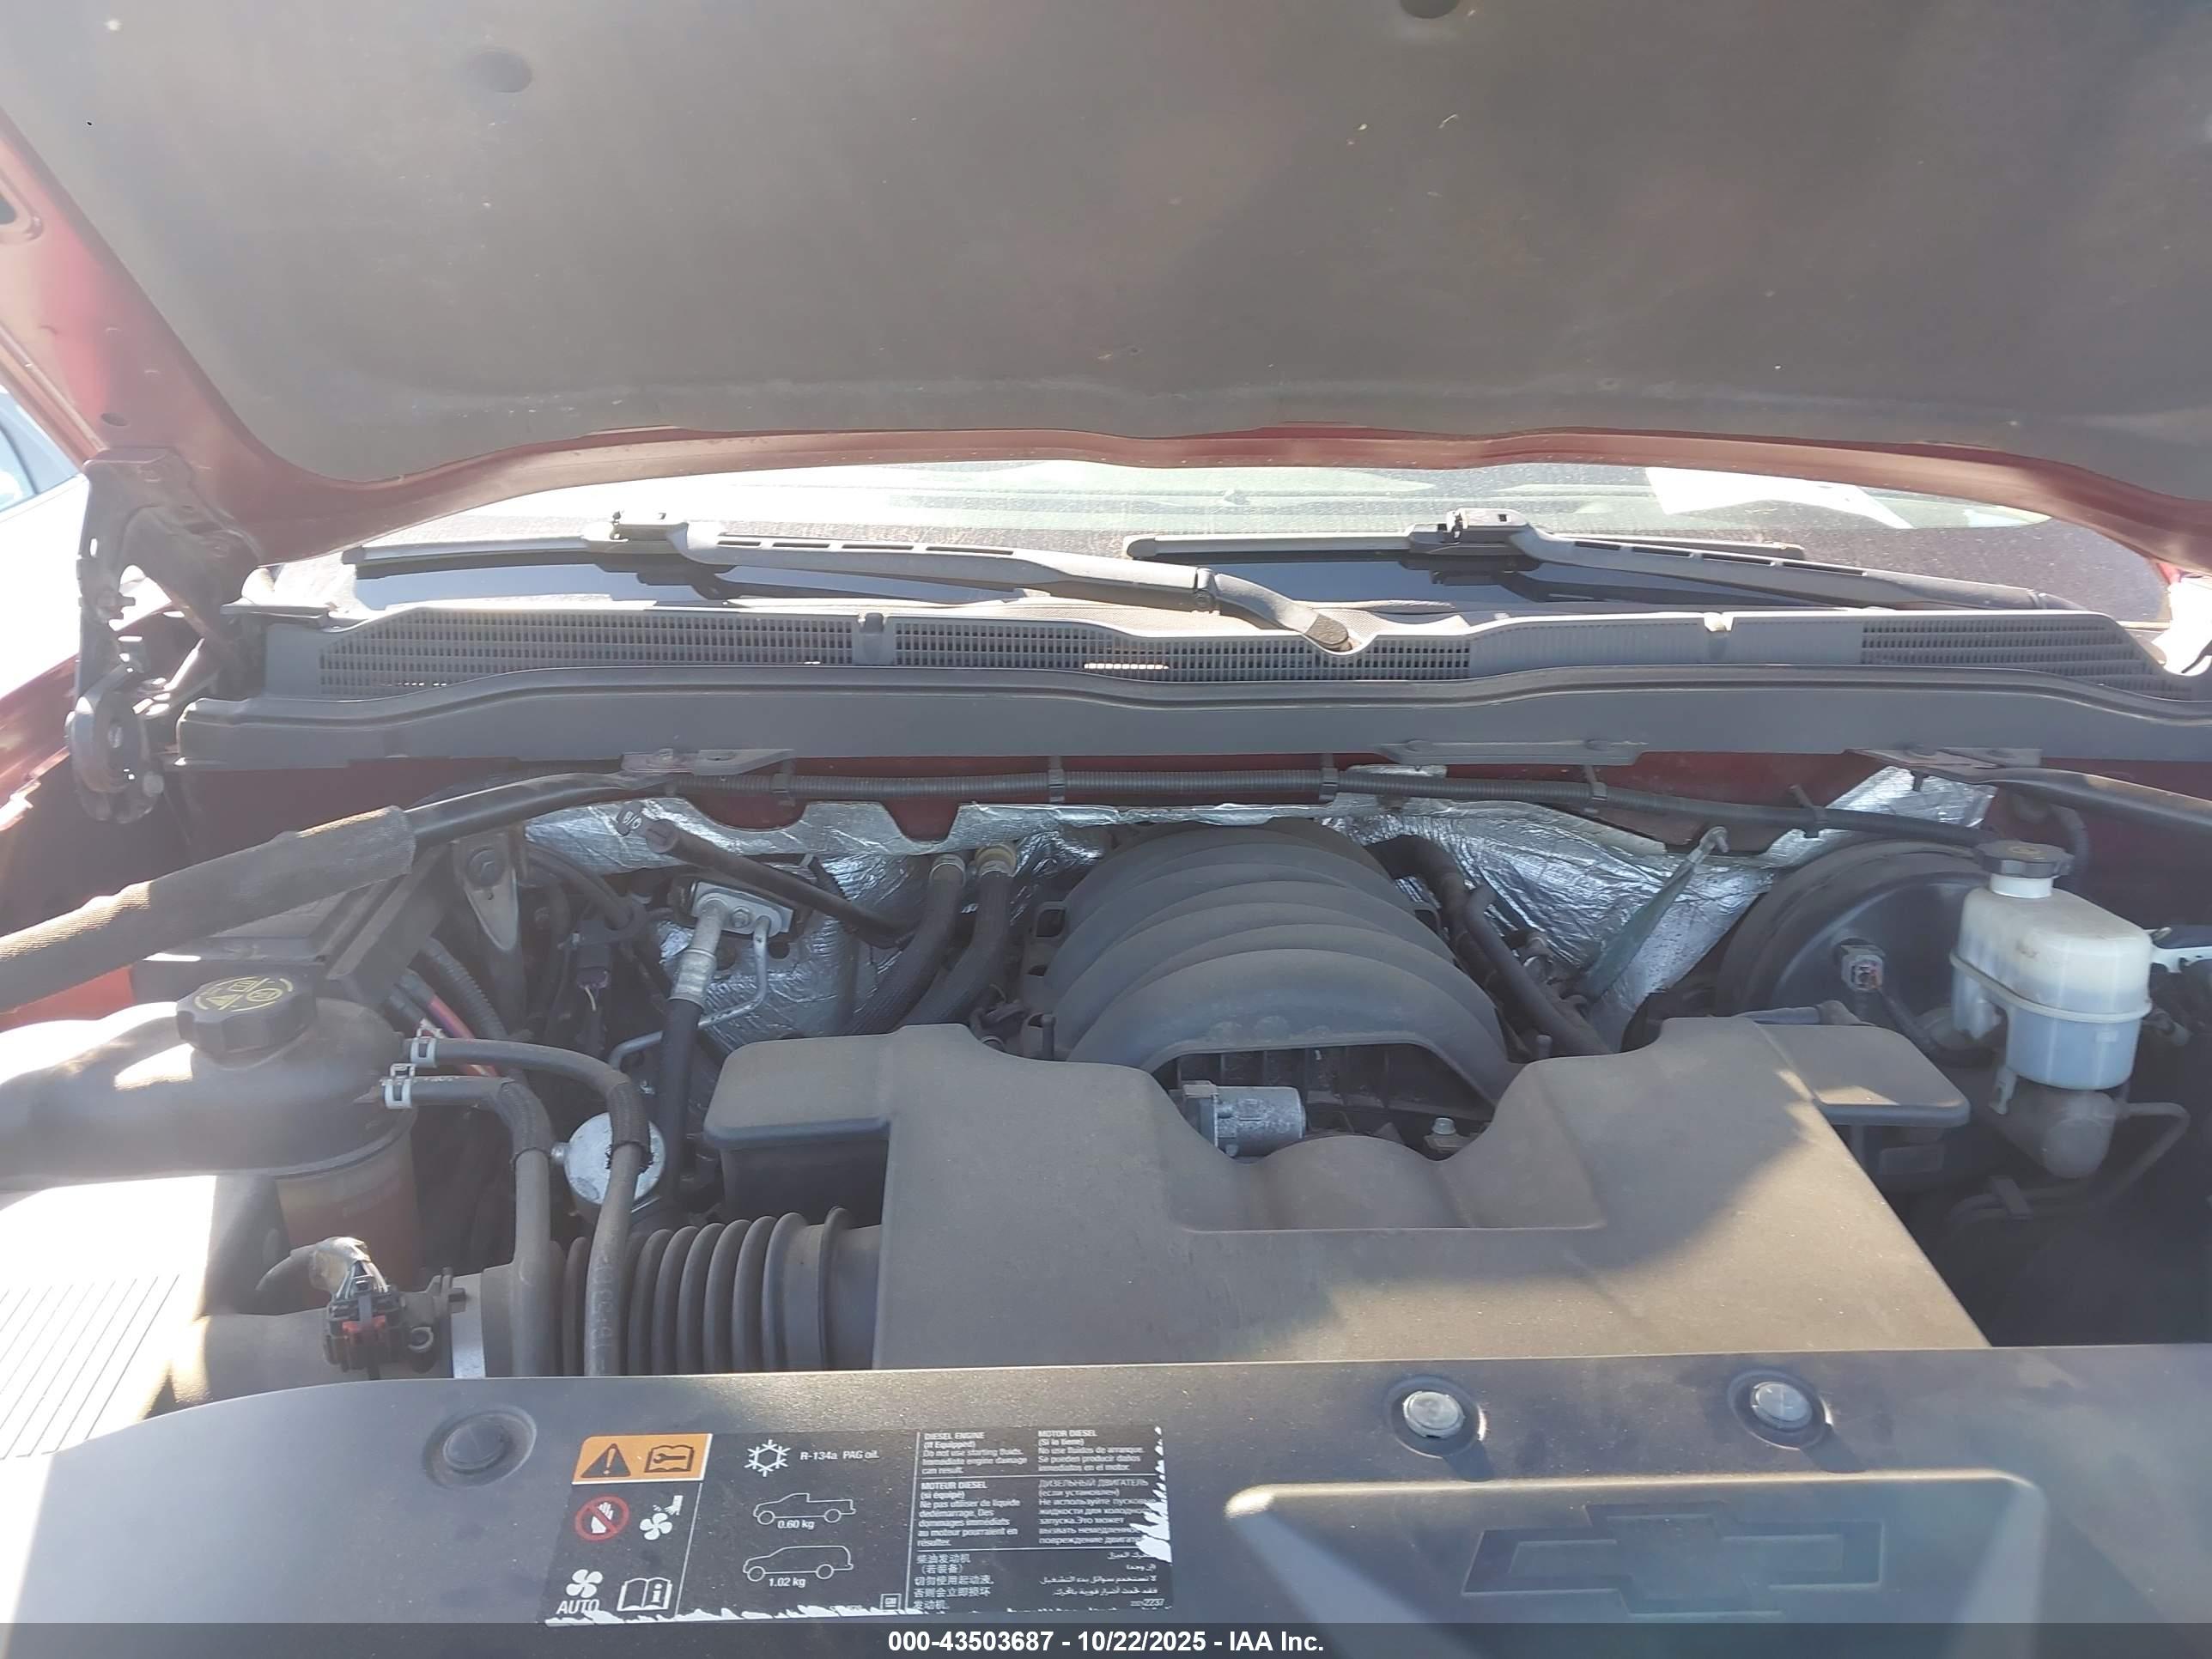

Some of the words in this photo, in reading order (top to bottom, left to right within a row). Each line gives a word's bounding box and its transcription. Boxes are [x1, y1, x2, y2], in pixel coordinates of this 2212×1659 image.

[800, 1452, 838, 1461] R-134a
[1082, 1455, 1115, 1463] producir
[1038, 1479, 1096, 1488] ДИЗЕЛЬНЫЙ
[1054, 1498, 1110, 1506] используйте
[777, 1520, 799, 1528] 0.60
[802, 1520, 815, 1529] kg
[962, 1528, 1006, 1537] pourraient
[916, 1553, 970, 1564] 柴油发动机
[769, 1578, 790, 1587] 1.02
[793, 1577, 806, 1588] kg
[914, 1586, 991, 1598] 否则会立即损坏
[556, 1599, 599, 1614] AUTO
